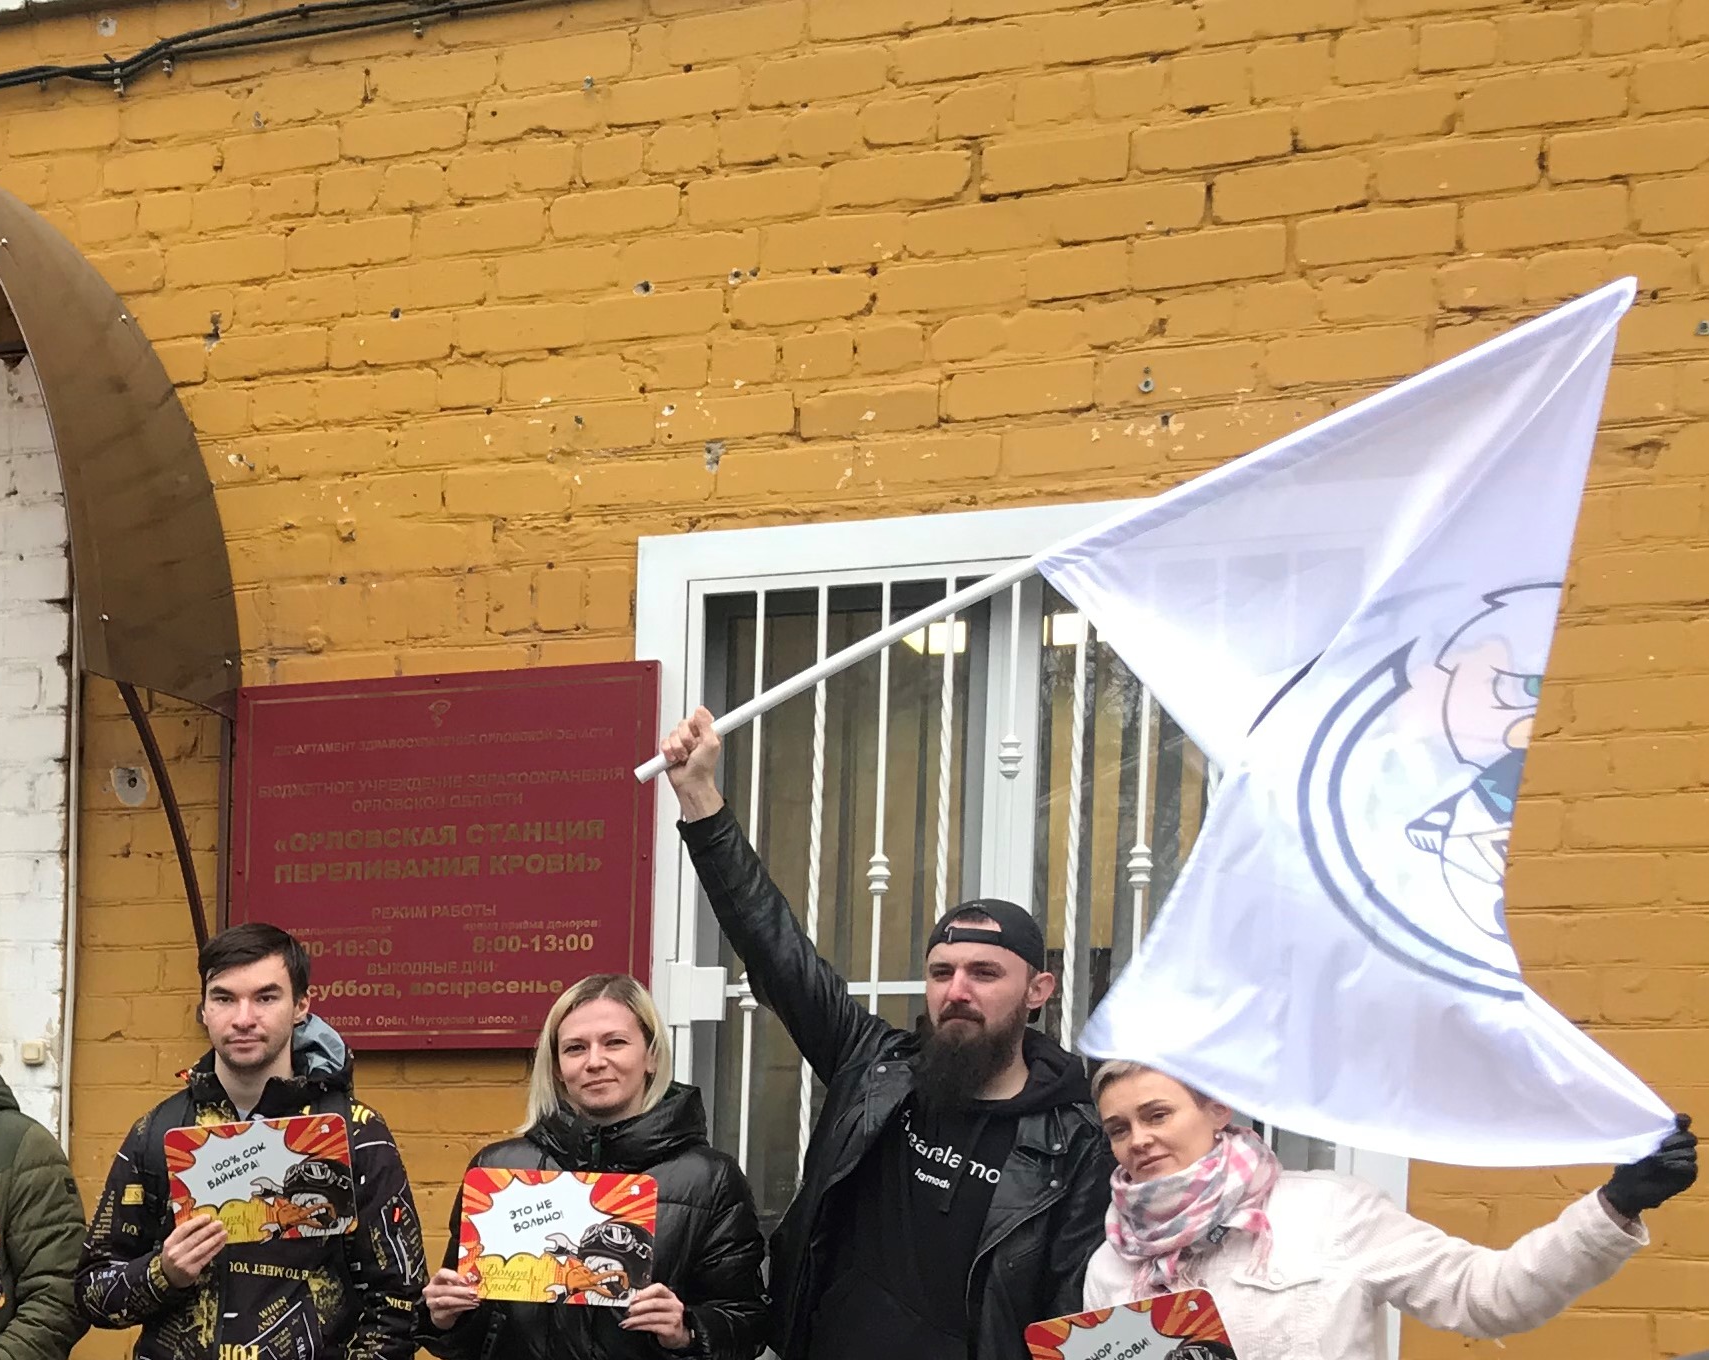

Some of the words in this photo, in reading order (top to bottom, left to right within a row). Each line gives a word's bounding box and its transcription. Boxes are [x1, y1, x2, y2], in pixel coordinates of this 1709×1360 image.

[258, 781, 355, 799] БЮДЖЕТНОЕ
[358, 775, 462, 793] УЧРЕЖДЕНИЕ
[467, 767, 626, 788] ЗДРАВООХРАНЕНИЯ
[351, 796, 446, 813] ОРЛОВСКОЙ
[449, 792, 524, 808] ОБЛАСТИ
[274, 825, 457, 852] «ОРЛОВСКАЯ
[466, 819, 606, 844] СТАНЦИЯ
[274, 856, 481, 884] ПЕРЕЛИВАНИЯ
[491, 853, 603, 875] КРОВИ»
[371, 906, 427, 920] РЕЖИМ
[431, 904, 497, 918] РАБОТЫ
[473, 933, 594, 953] 8:00-13:00
[367, 960, 457, 976] ВЫХОДНЫЕ
[306, 979, 402, 1001] суббота,
[409, 979, 564, 999] воскресенье
[242, 1142, 267, 1160] СОК
[206, 1160, 260, 1191] БАЙКЕРА!
[211, 1155, 241, 1174] 100%
[509, 1205, 533, 1221] ЭТО
[536, 1198, 553, 1211] НЕ
[513, 1210, 565, 1234] БОЛЬНО!
